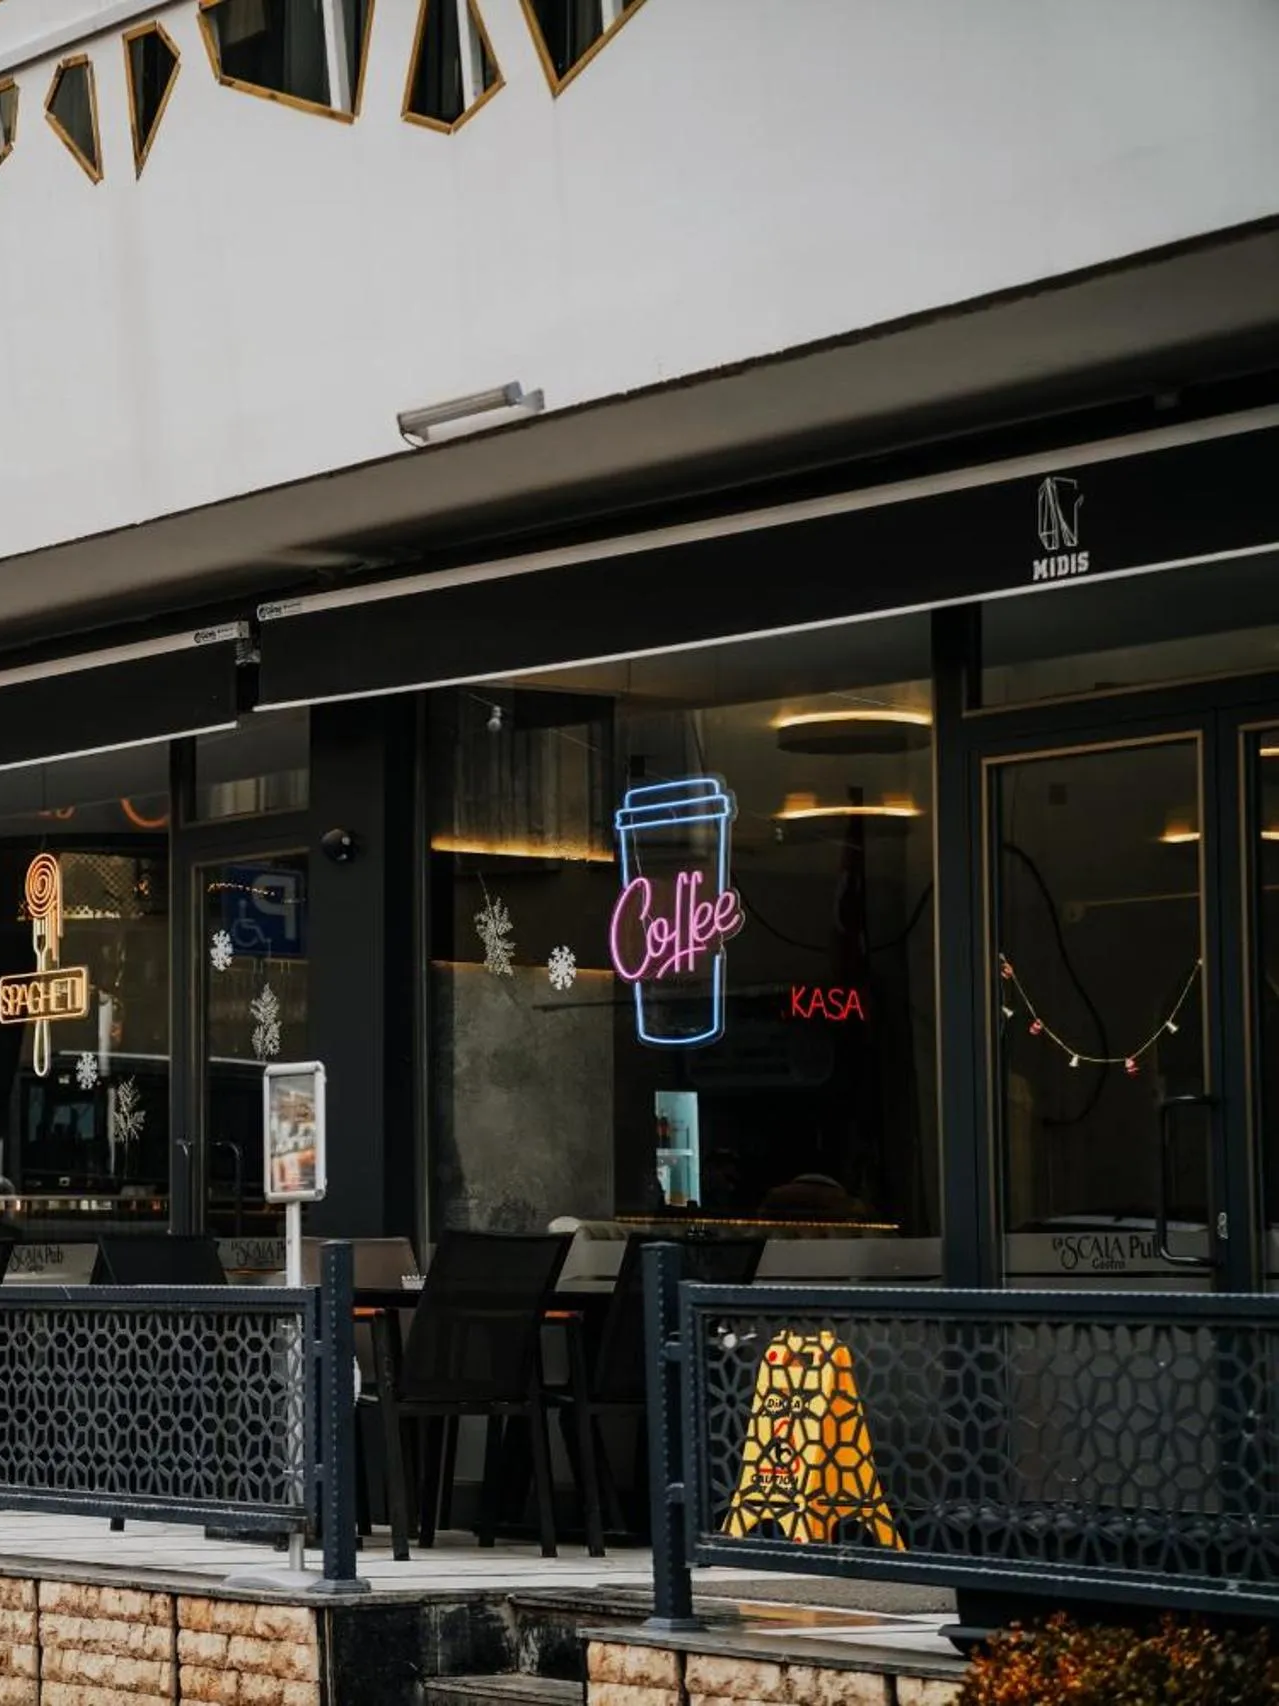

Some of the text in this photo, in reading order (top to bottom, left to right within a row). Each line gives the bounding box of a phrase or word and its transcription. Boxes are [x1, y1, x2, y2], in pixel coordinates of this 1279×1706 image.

[1032, 550, 1089, 581] MIDIS
[610, 871, 741, 979] Coffee
[791, 985, 865, 1021] KASA
